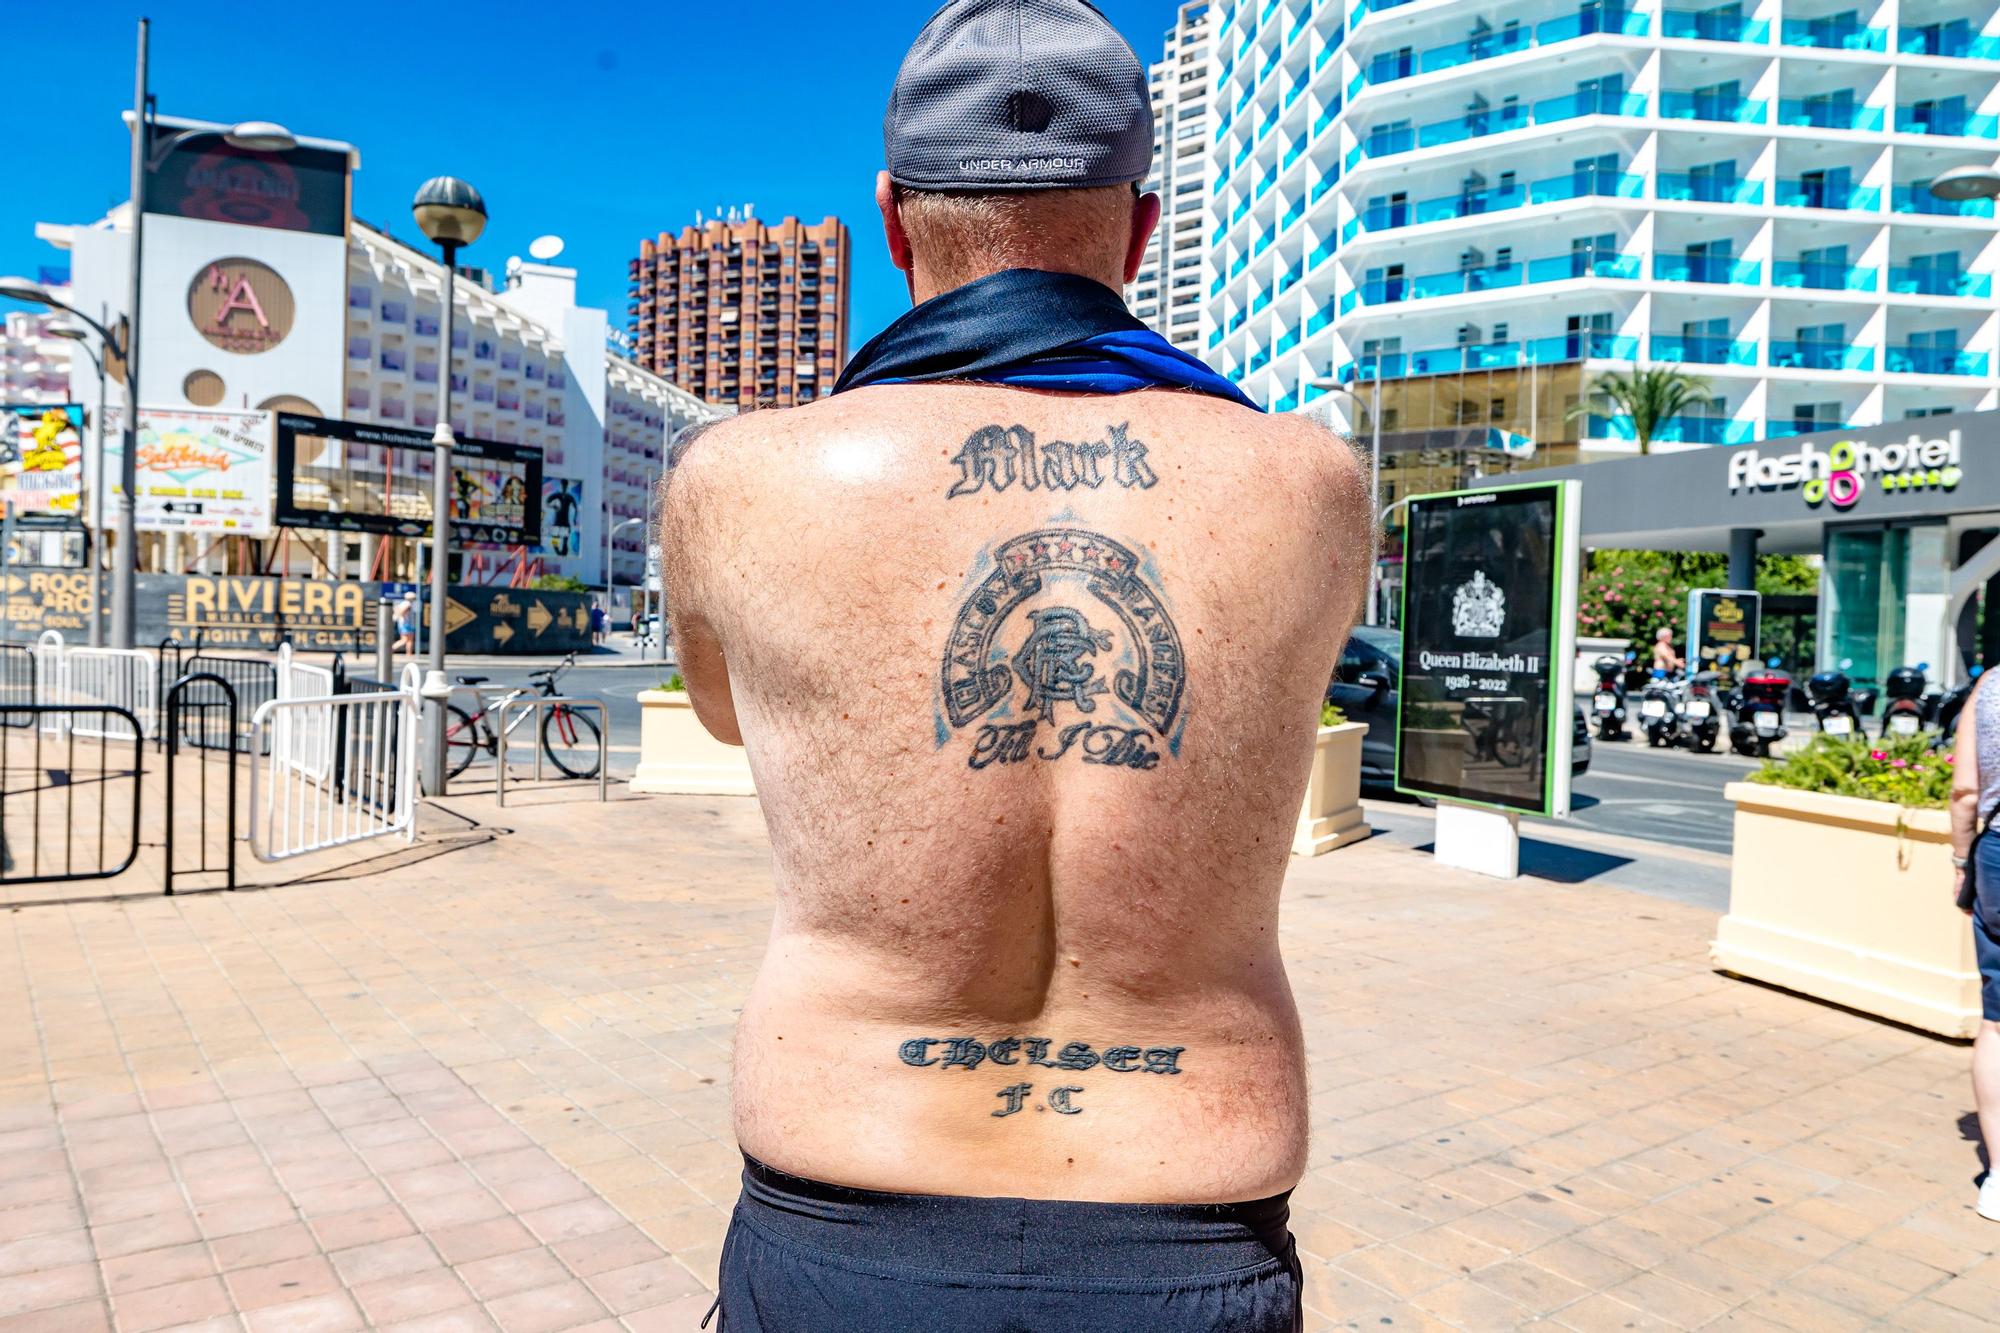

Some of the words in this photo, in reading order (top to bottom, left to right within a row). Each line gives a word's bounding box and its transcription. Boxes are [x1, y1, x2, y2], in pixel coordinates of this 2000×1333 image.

[959, 160, 1012, 171] UNDER
[1014, 158, 1085, 171] ARMOUR
[945, 421, 1159, 499] Mark
[1728, 441, 1831, 490] flash
[1855, 430, 1961, 473] hotel
[186, 578, 363, 628] RIVIERA
[206, 611, 263, 625] MUSIC
[1420, 651, 1460, 671] Queen
[1462, 652, 1525, 673] Elizabeth
[1527, 656, 1539, 673] II
[1445, 674, 1470, 690] 1926
[1479, 678, 1507, 691] 2022
[1082, 725, 1160, 769] Die
[898, 1036, 1186, 1075] CHELSEA
